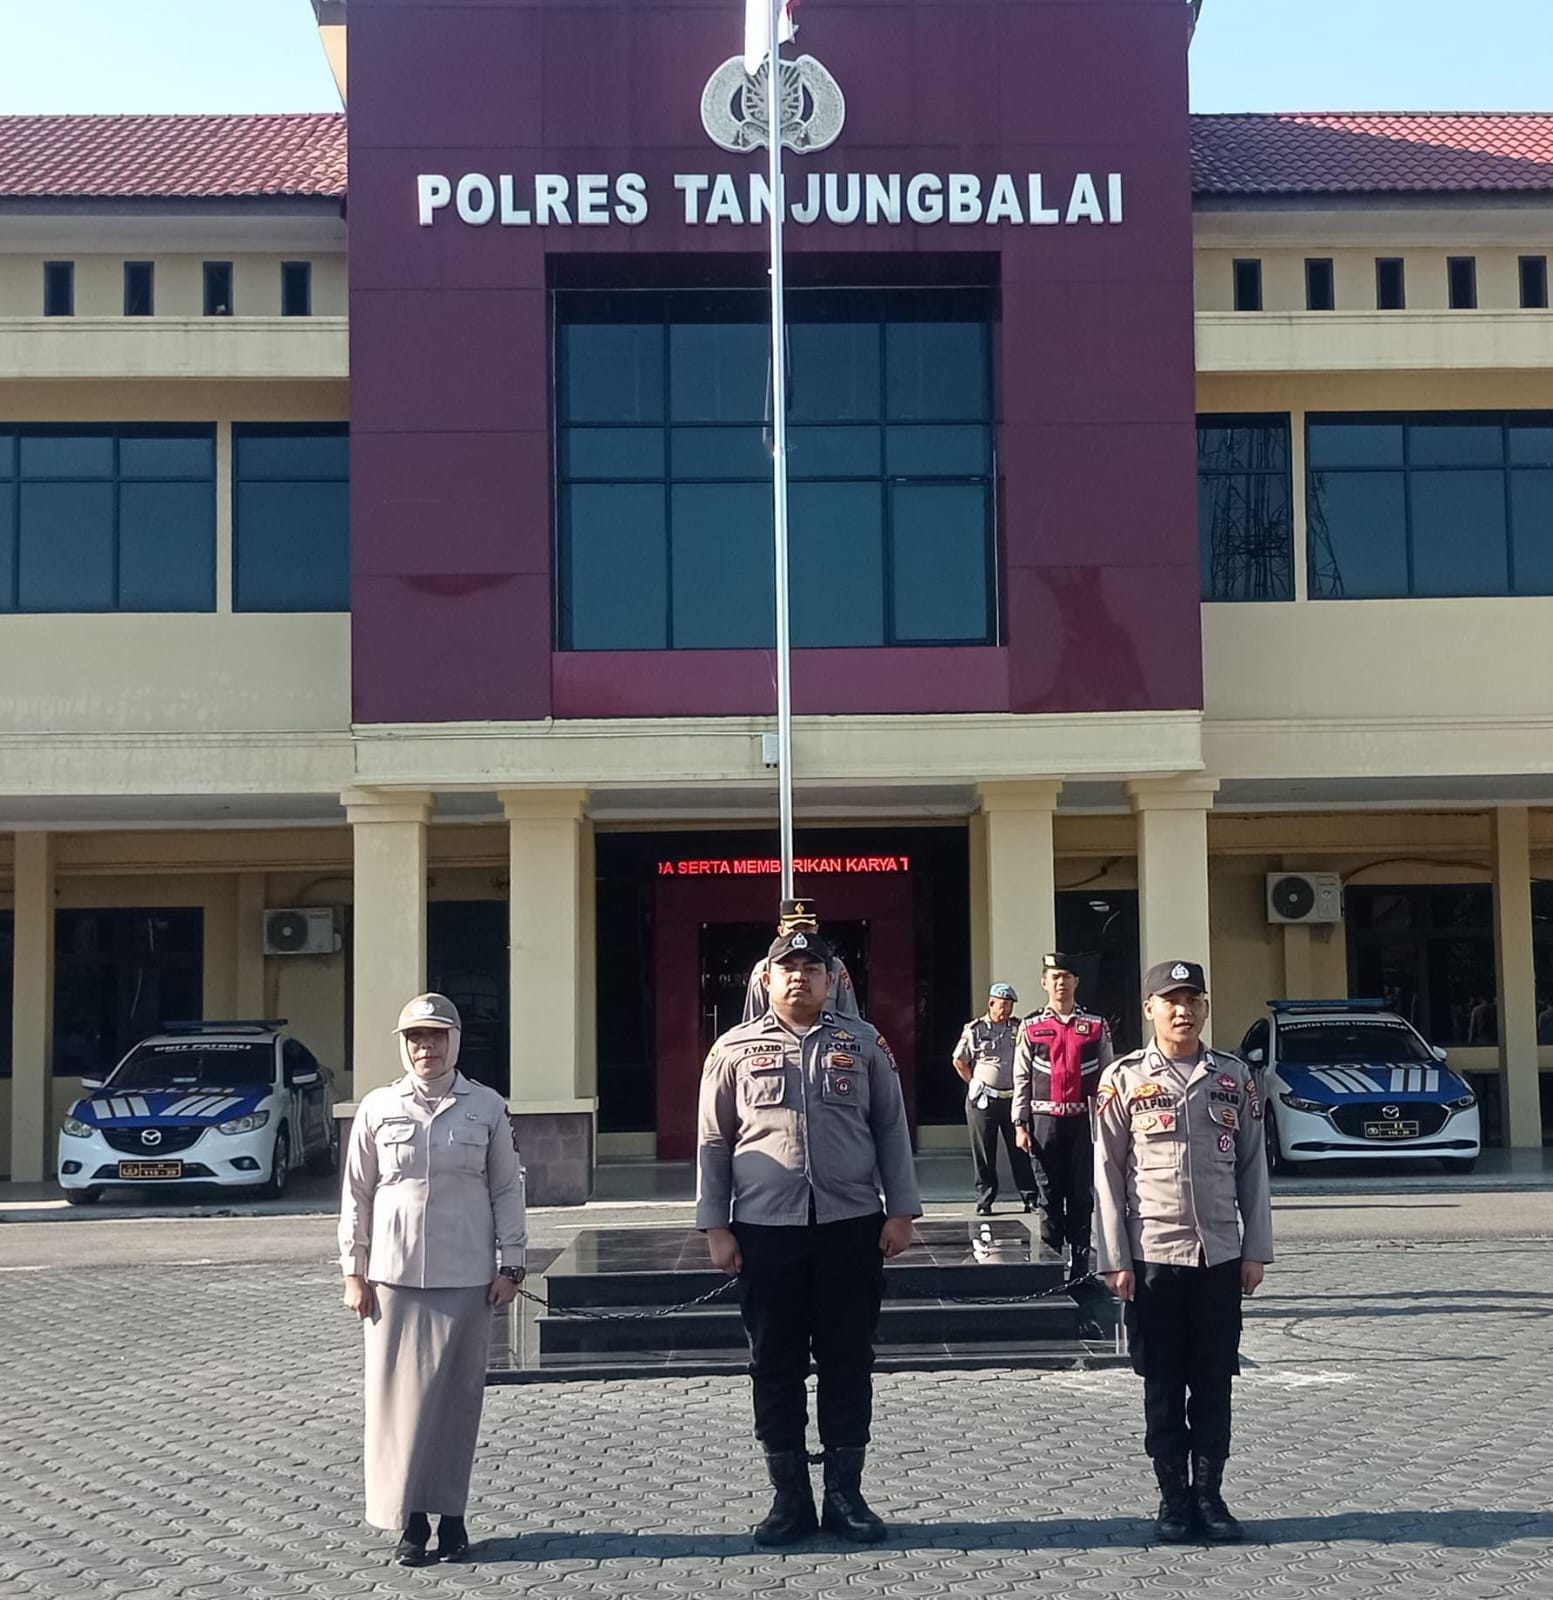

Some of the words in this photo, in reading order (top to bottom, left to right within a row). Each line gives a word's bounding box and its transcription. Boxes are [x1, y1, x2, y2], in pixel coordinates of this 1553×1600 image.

[417, 172, 649, 226] POLRES
[674, 172, 1123, 226] TANJUNGBALAI
[678, 860, 731, 875] SERTA
[733, 858, 842, 874] MEMBRIKAN
[846, 857, 898, 872] KARYA
[825, 1042, 861, 1053] POLRI
[1307, 1063, 1432, 1071] POLISI
[114, 1087, 235, 1096] POLISI
